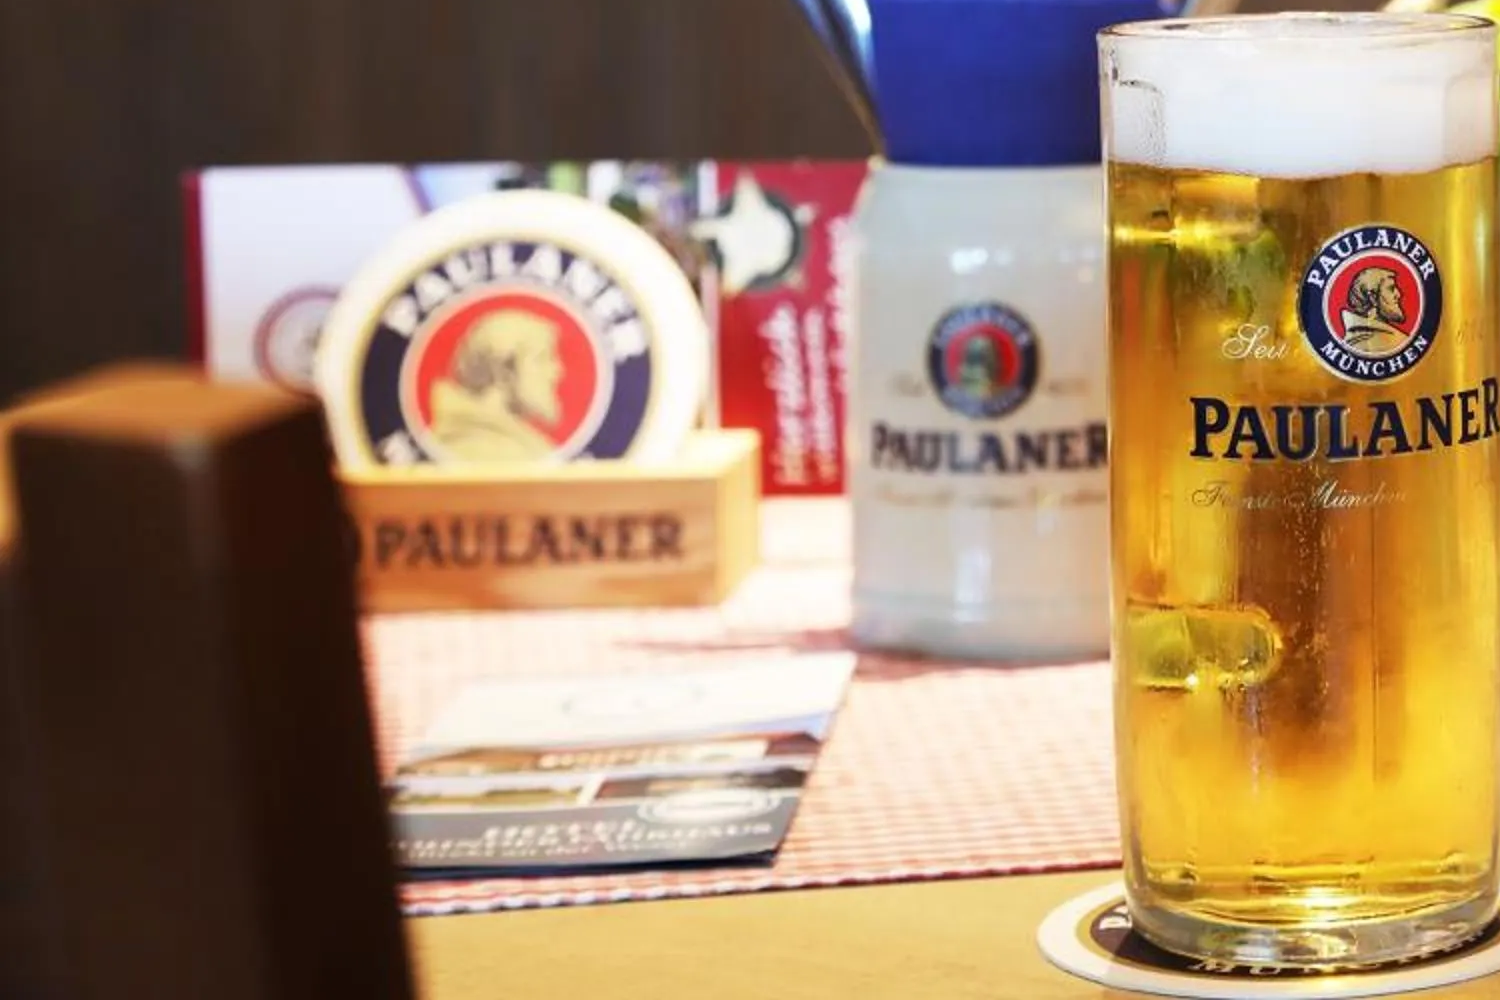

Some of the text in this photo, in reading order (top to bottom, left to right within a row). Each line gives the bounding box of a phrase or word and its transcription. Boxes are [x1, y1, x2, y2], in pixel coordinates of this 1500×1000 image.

[1308, 229, 1435, 288] PAULANER
[384, 244, 646, 363] PAULANER
[1190, 377, 1500, 461] PAULANER
[375, 512, 686, 566] PAULANER
